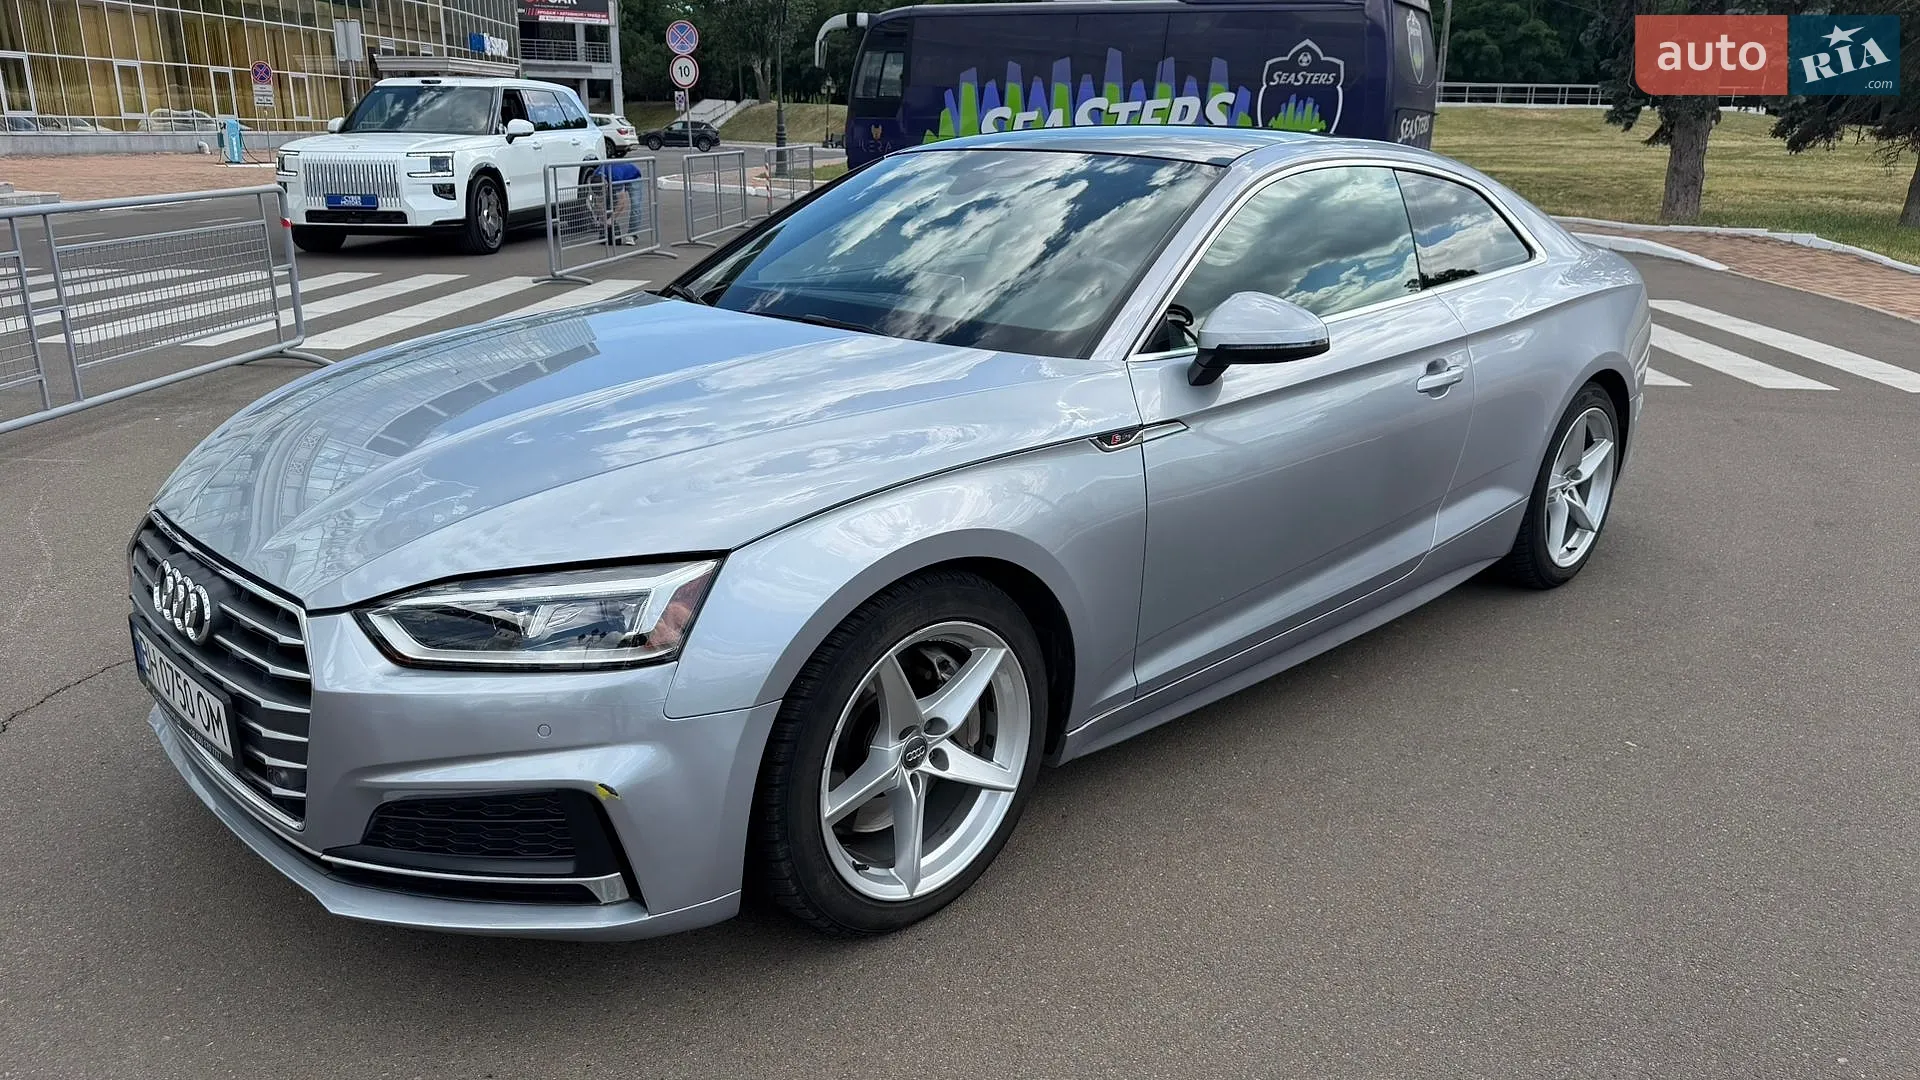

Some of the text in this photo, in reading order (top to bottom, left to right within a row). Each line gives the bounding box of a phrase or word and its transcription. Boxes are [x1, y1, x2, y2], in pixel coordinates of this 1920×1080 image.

[678, 65, 690, 78] 10
[1269, 71, 1337, 86] SEASTERS
[159, 656, 196, 719] 0750
[196, 690, 228, 747] OM
